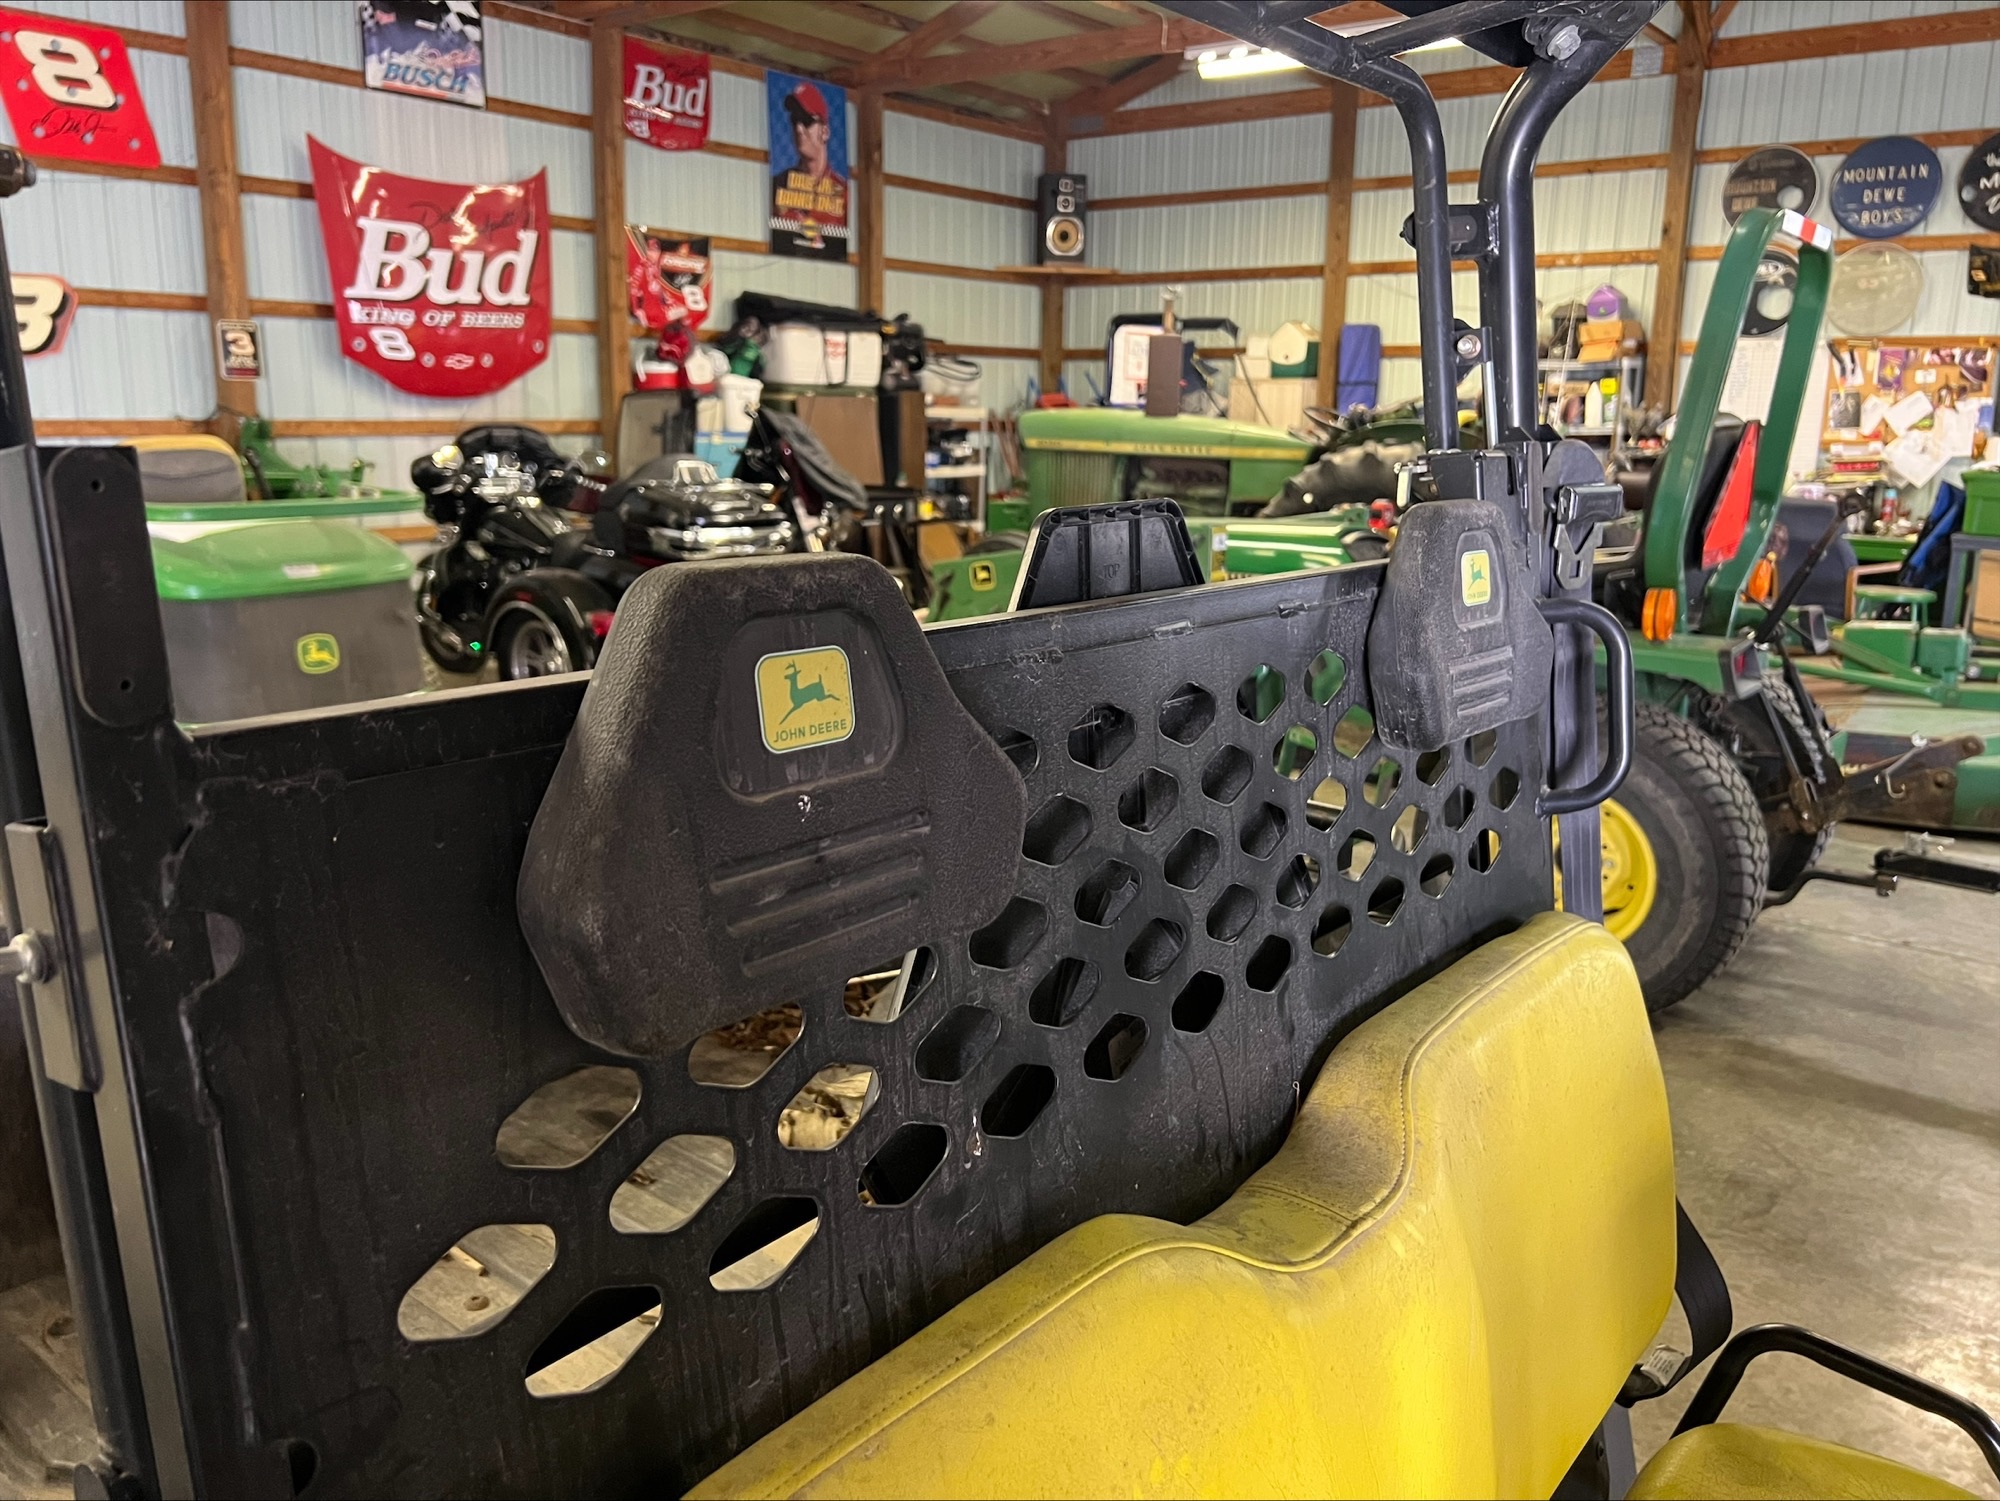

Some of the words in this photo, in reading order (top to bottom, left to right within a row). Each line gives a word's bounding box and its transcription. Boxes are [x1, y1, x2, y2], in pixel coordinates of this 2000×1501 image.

[14, 30, 116, 109] 8
[383, 62, 469, 94] BUSCH
[630, 64, 708, 117] Bud
[1843, 163, 1929, 184] MOUNTAIN
[1863, 186, 1907, 205] DEWE
[1861, 208, 1903, 227] BOYS
[344, 215, 538, 306] Bud
[681, 284, 708, 312] 8
[351, 306, 416, 328] KING
[422, 309, 455, 328] OF
[460, 311, 525, 329] BEERS
[225, 331, 256, 356] 3
[369, 326, 416, 361] 8
[773, 726, 806, 743] JOHN
[809, 719, 847, 736] DEERE
